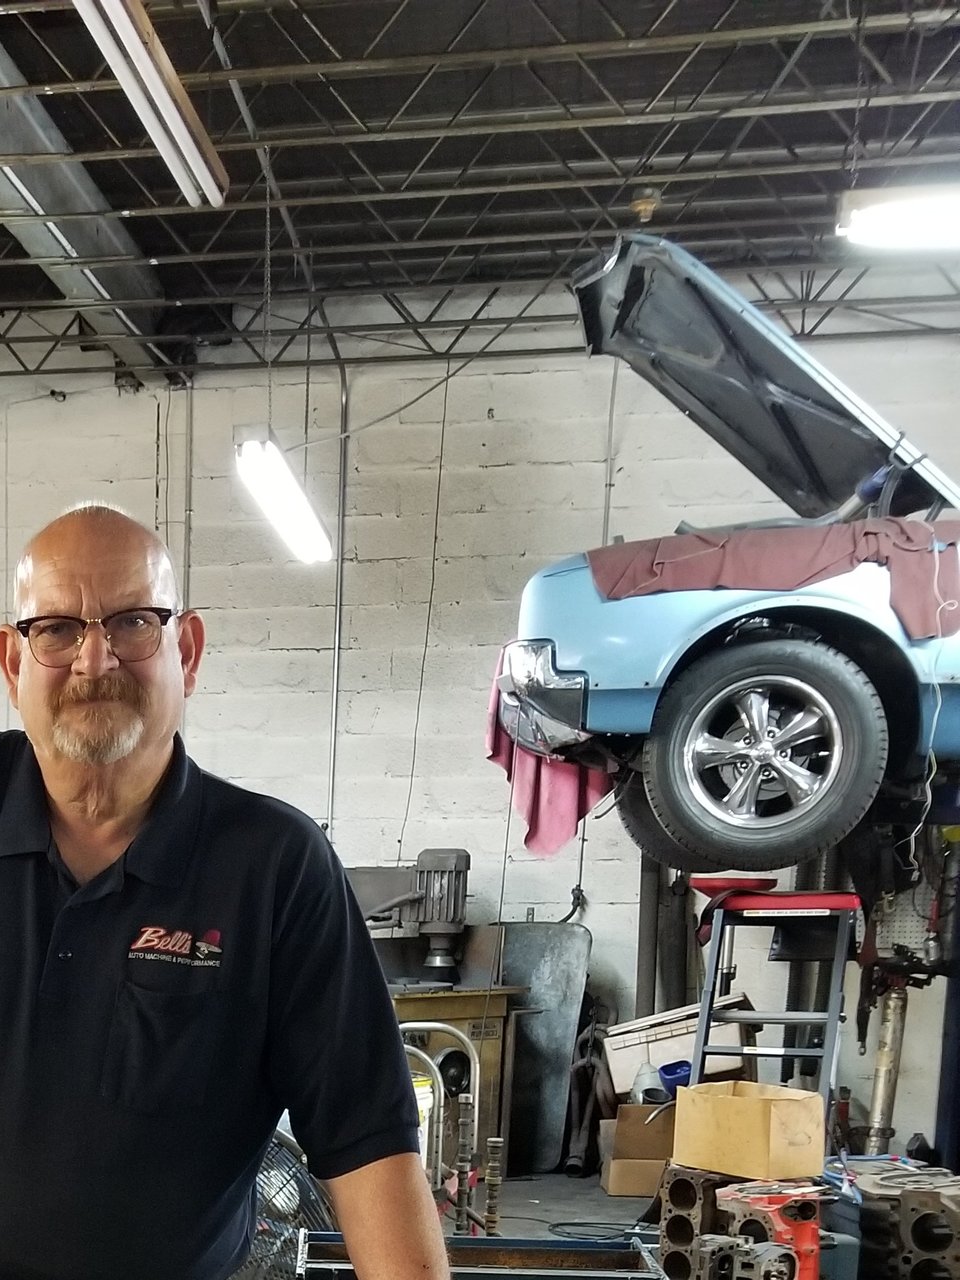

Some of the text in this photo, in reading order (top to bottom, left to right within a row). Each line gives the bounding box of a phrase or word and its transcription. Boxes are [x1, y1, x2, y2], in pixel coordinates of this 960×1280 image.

[131, 926, 192, 954] Bell's
[128, 952, 144, 960] AUTO
[145, 953, 172, 962] MACHINE
[177, 957, 221, 968] PERFORMANCE
